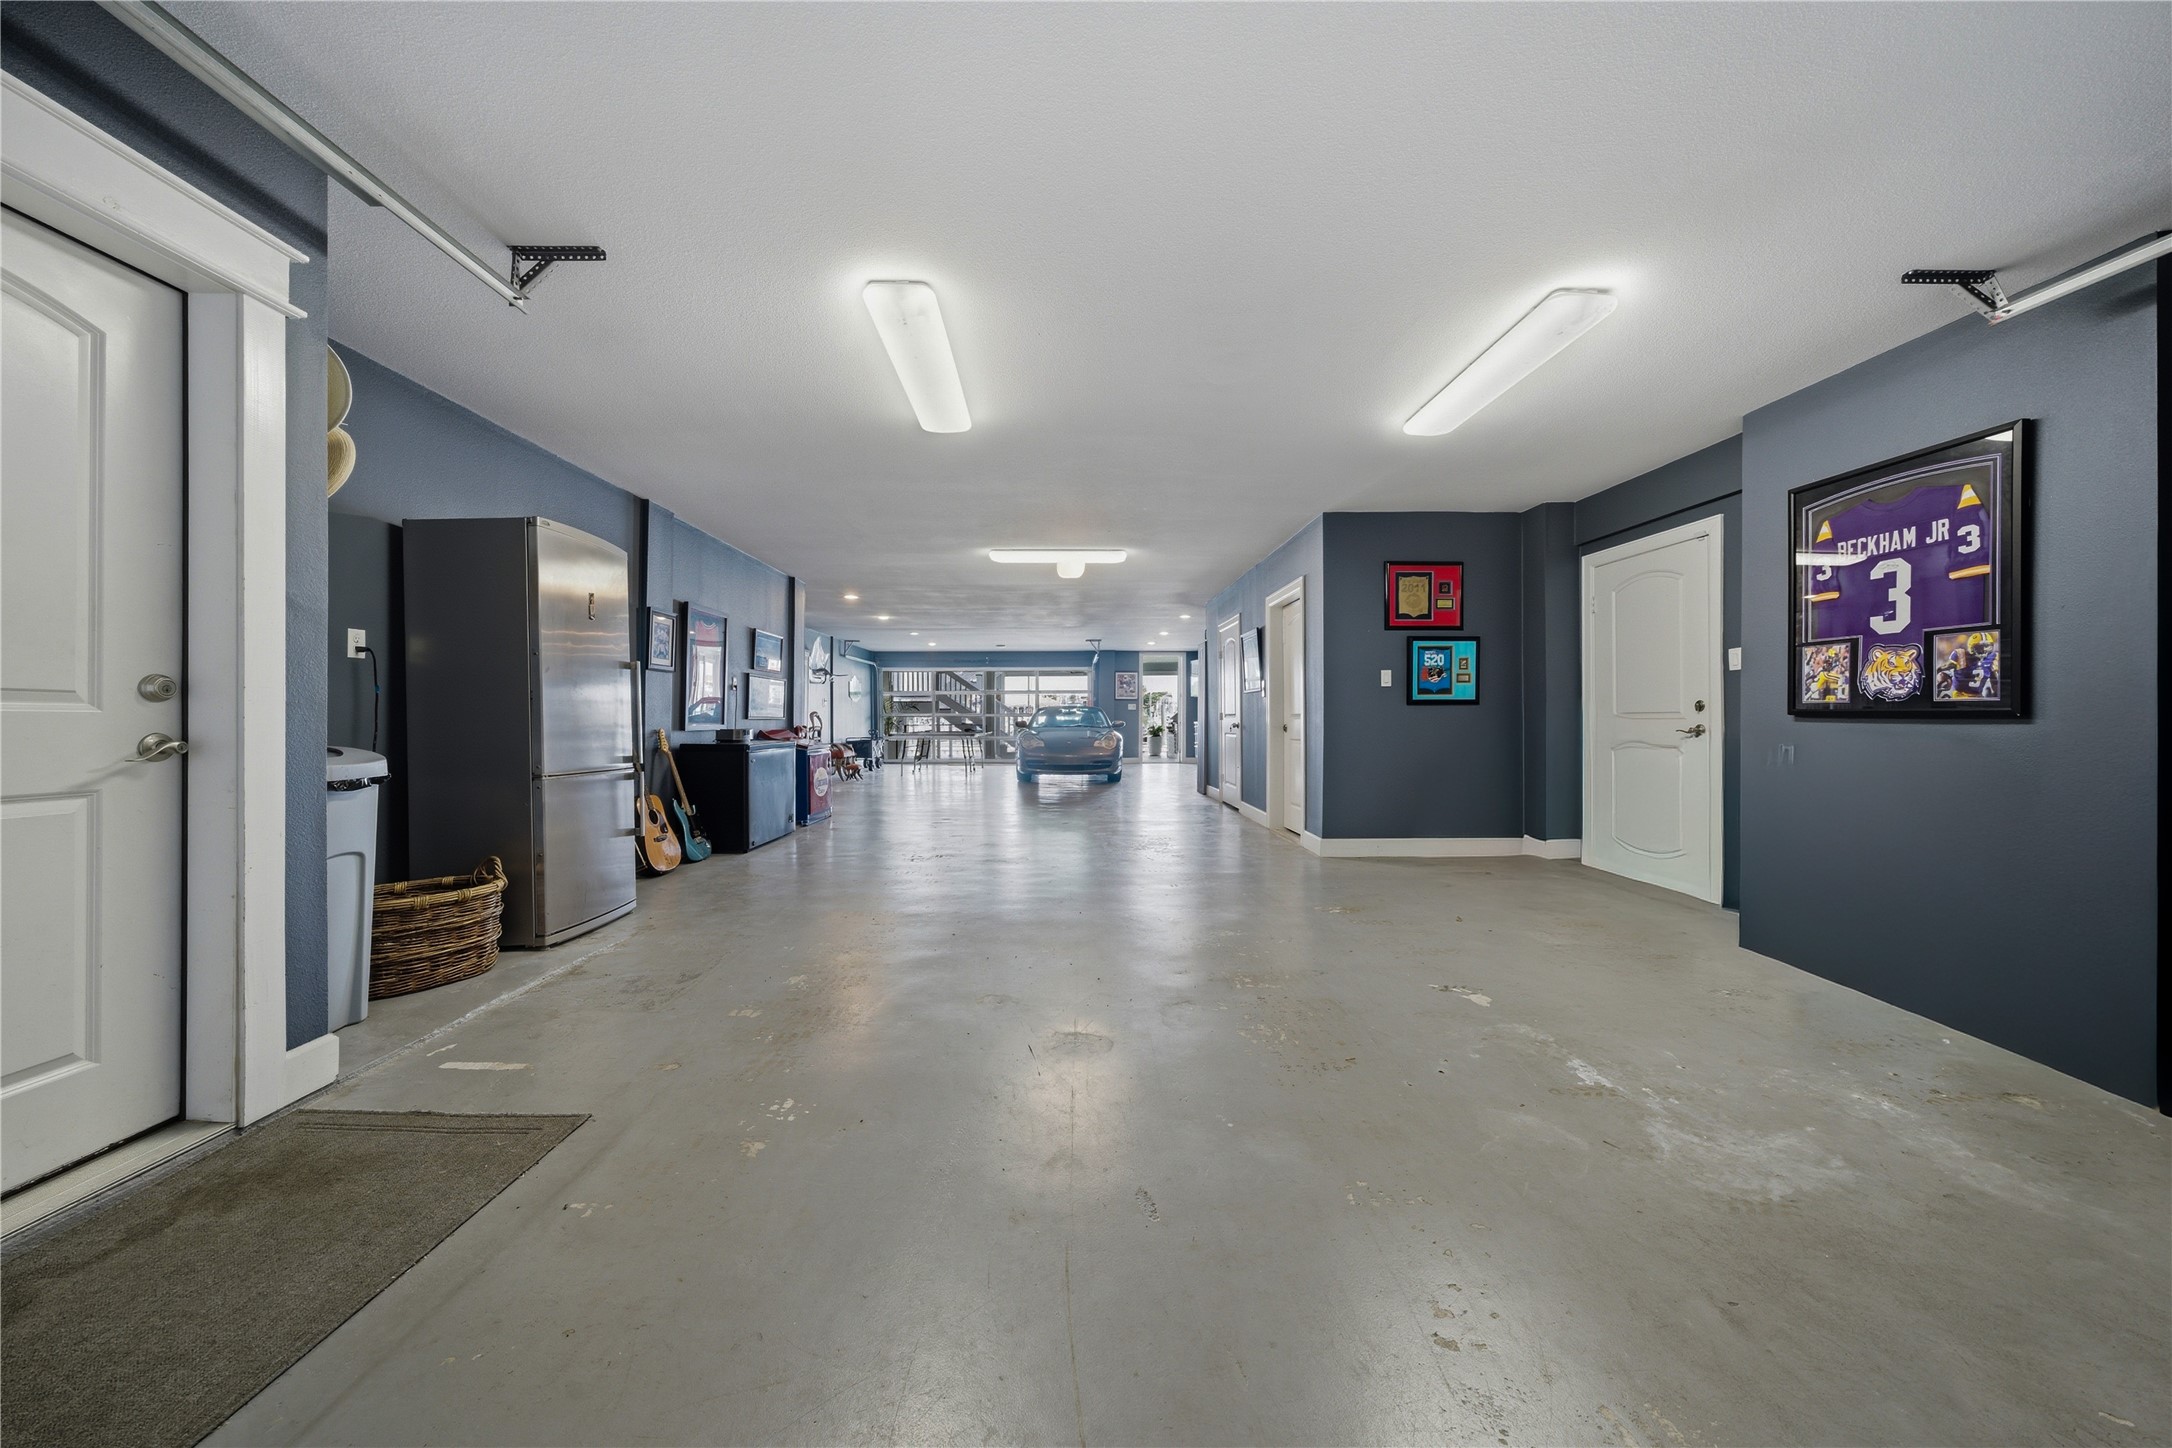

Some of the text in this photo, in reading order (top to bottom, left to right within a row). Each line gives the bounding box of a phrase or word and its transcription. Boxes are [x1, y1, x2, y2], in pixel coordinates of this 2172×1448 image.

[1837, 518, 1950, 559] BECKHAM JR
[1956, 524, 1981, 554] 3
[1816, 557, 1833, 581] 3
[1869, 557, 1912, 635] 3
[1424, 654, 1444, 666] 520
[1968, 669, 1984, 688] 3
